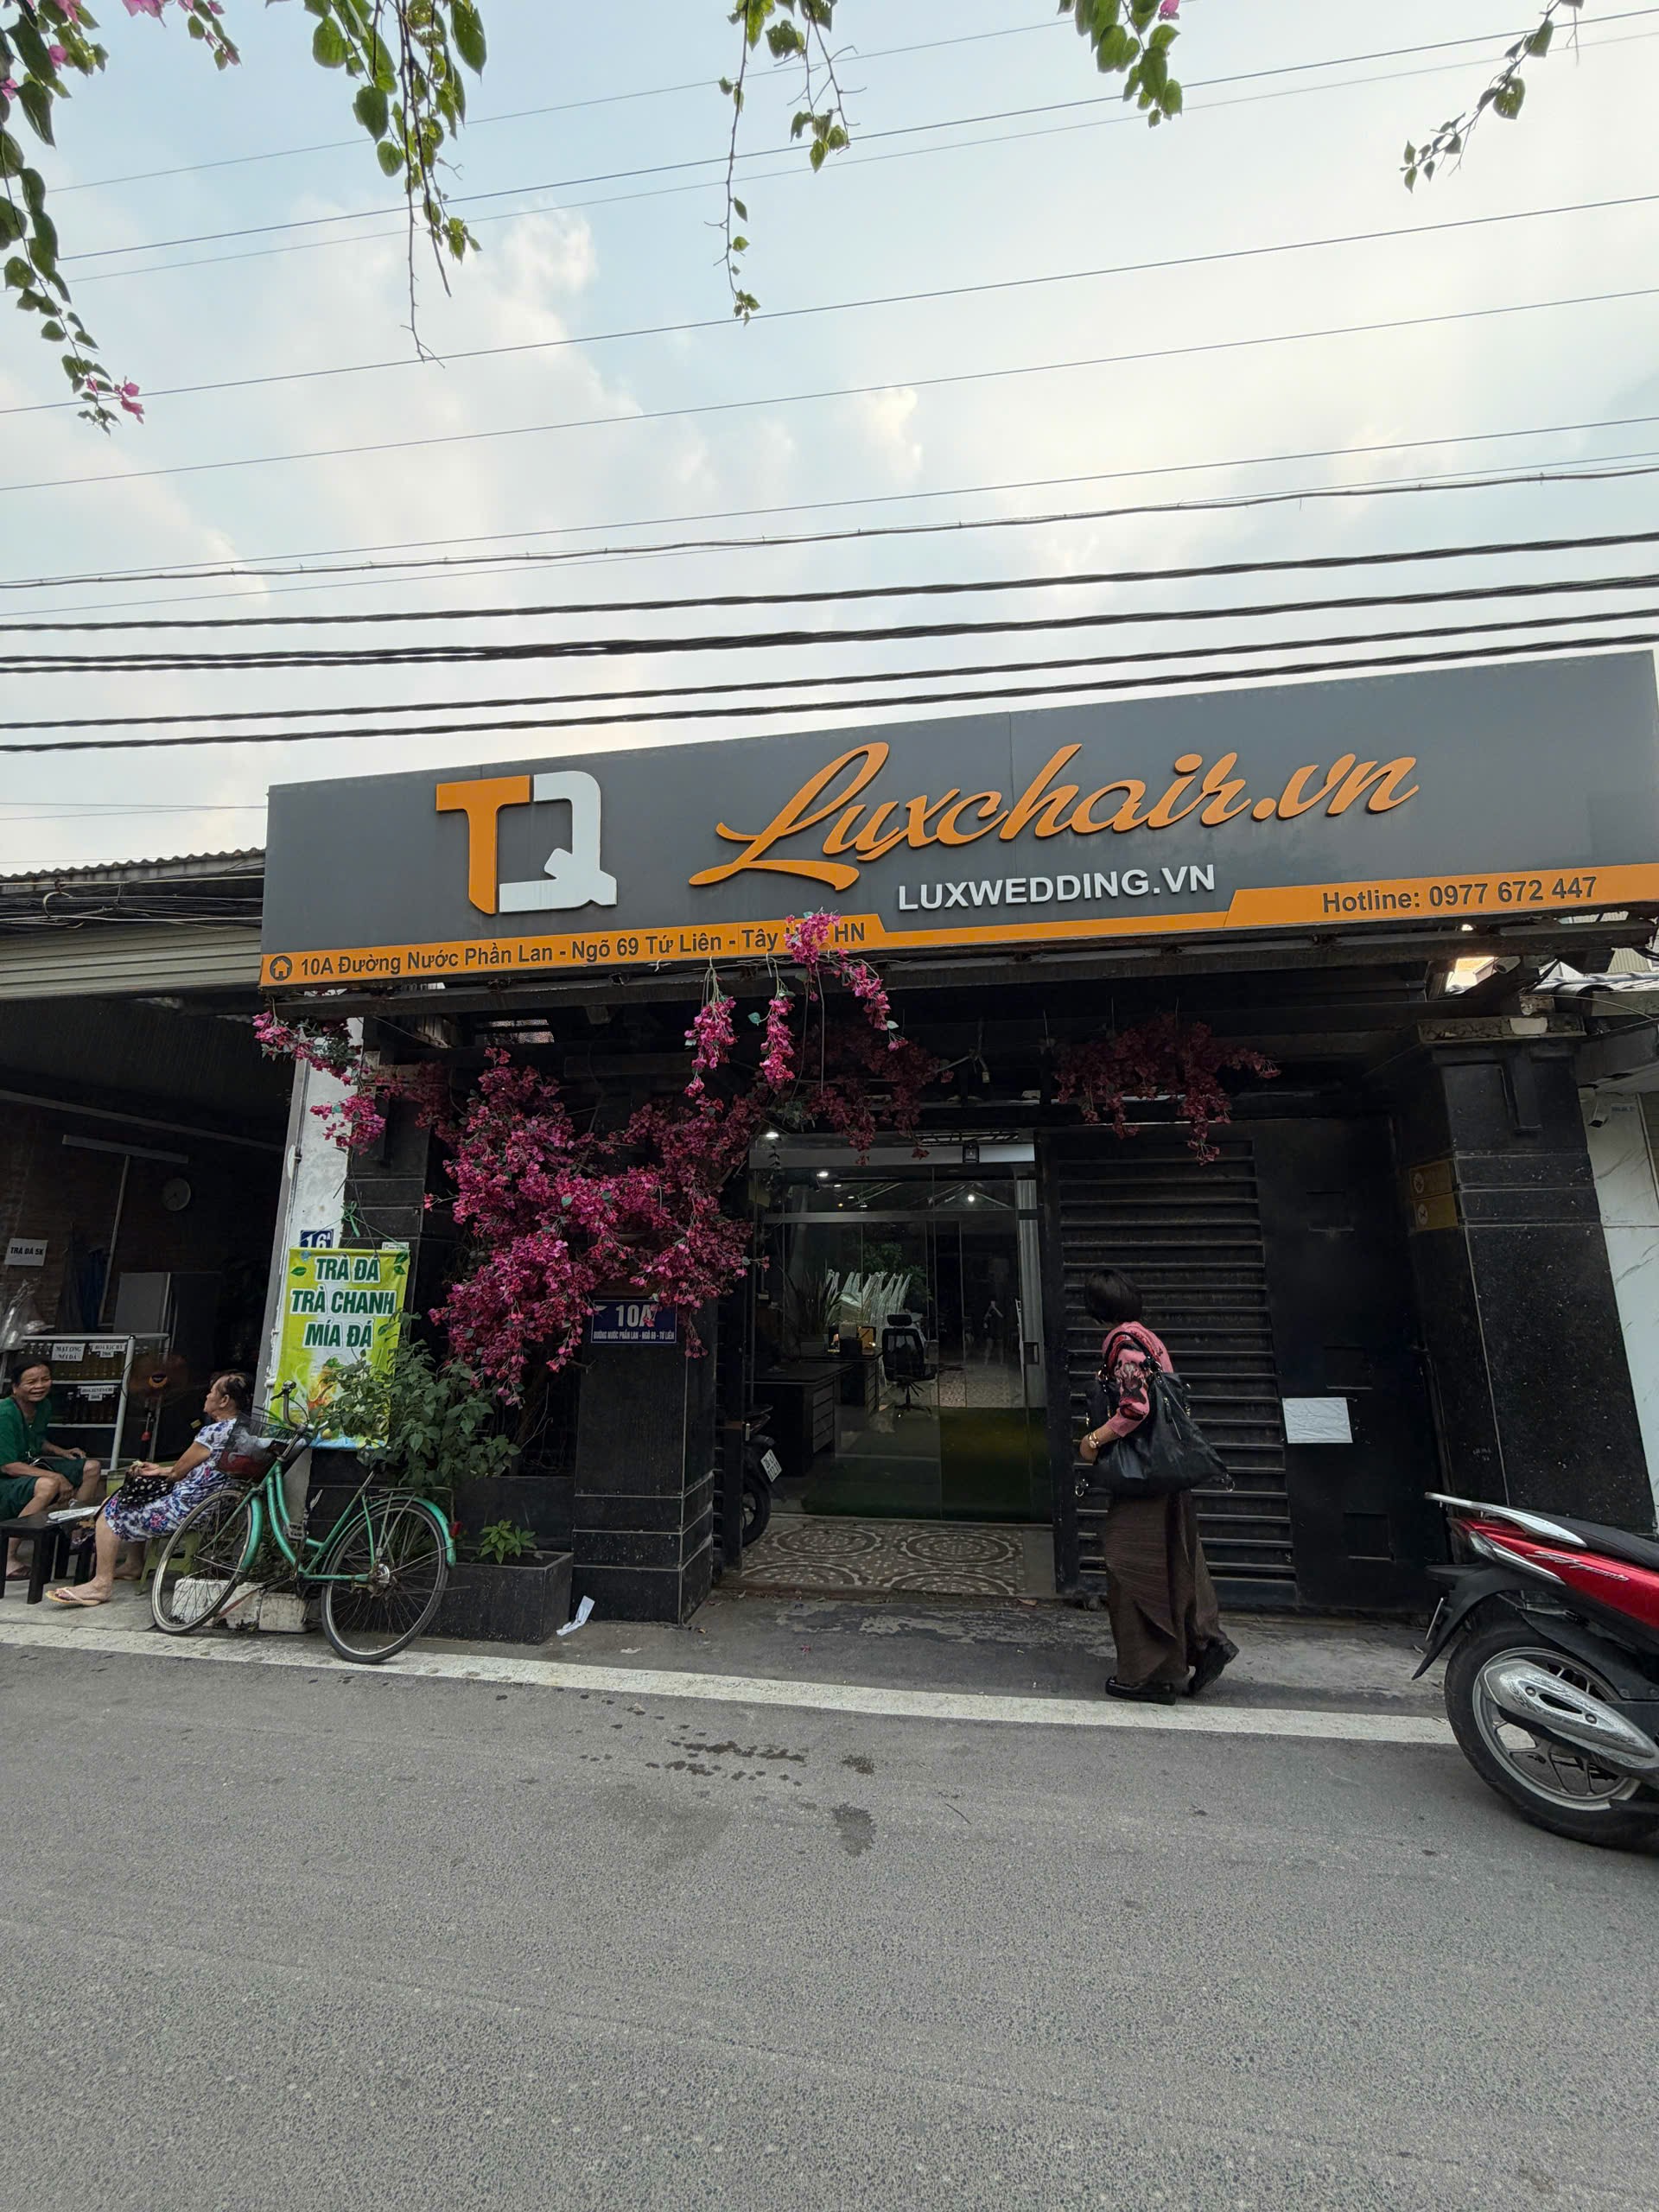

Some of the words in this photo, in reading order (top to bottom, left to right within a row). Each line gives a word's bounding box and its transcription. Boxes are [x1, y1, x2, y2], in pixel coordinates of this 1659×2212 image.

[689, 741, 1420, 892] Luxchair.vn
[898, 864, 1216, 911] LUXWEDDING.VN
[1323, 890, 1421, 913] Hotline:
[1429, 883, 1488, 907] 0977
[1497, 880, 1543, 903] 672
[1551, 875, 1597, 899] 447
[301, 957, 334, 976] 10A
[338, 954, 401, 976] Đường
[407, 950, 459, 970] Nước
[464, 942, 512, 966] Phần
[518, 944, 553, 963] Lan
[571, 940, 610, 963] Ngõ
[616, 938, 639, 956] 69
[645, 934, 674, 955] Tứ
[679, 930, 721, 951] Liên
[741, 928, 779, 951] Tây
[834, 922, 865, 943] HN
[292, 1286, 326, 1313] TRÀ
[330, 1290, 396, 1314] CHANH
[615, 1304, 654, 1327] 10A
[304, 1319, 341, 1347] MÍA
[346, 1320, 372, 1348] ĐÁ
